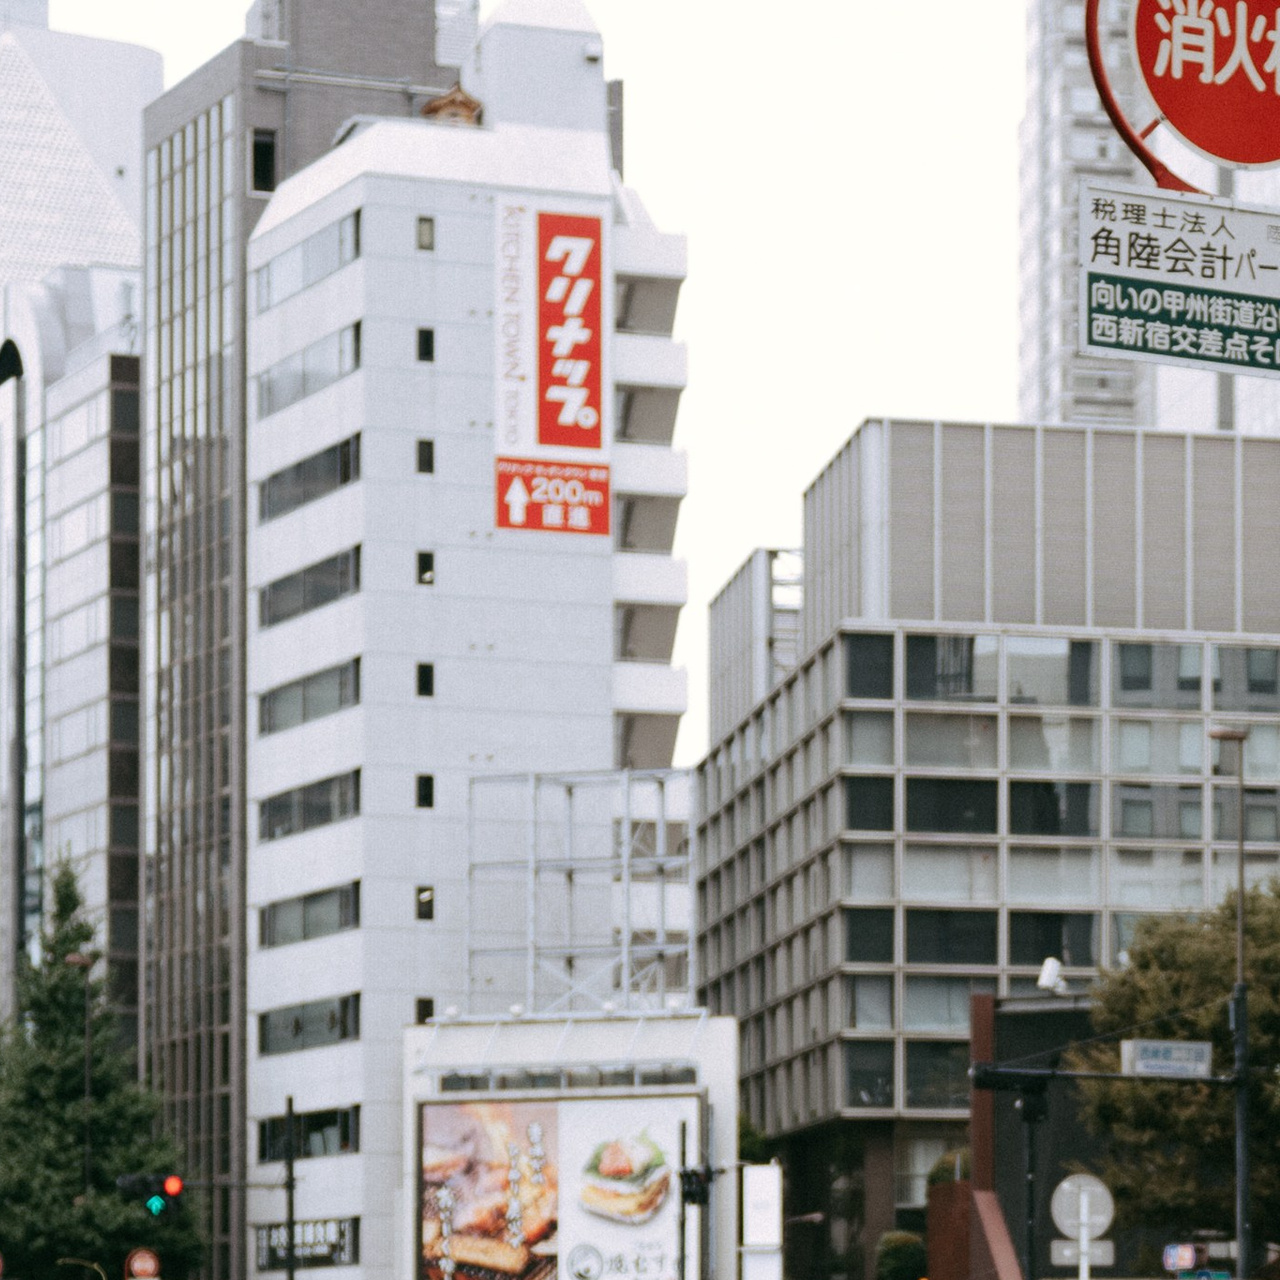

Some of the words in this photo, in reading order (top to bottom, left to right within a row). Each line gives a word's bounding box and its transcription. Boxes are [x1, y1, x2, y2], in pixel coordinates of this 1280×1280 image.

[1091, 197, 1235, 240] 税理士法人
[545, 234, 599, 429] クリナップ
[531, 476, 604, 507] 200m
